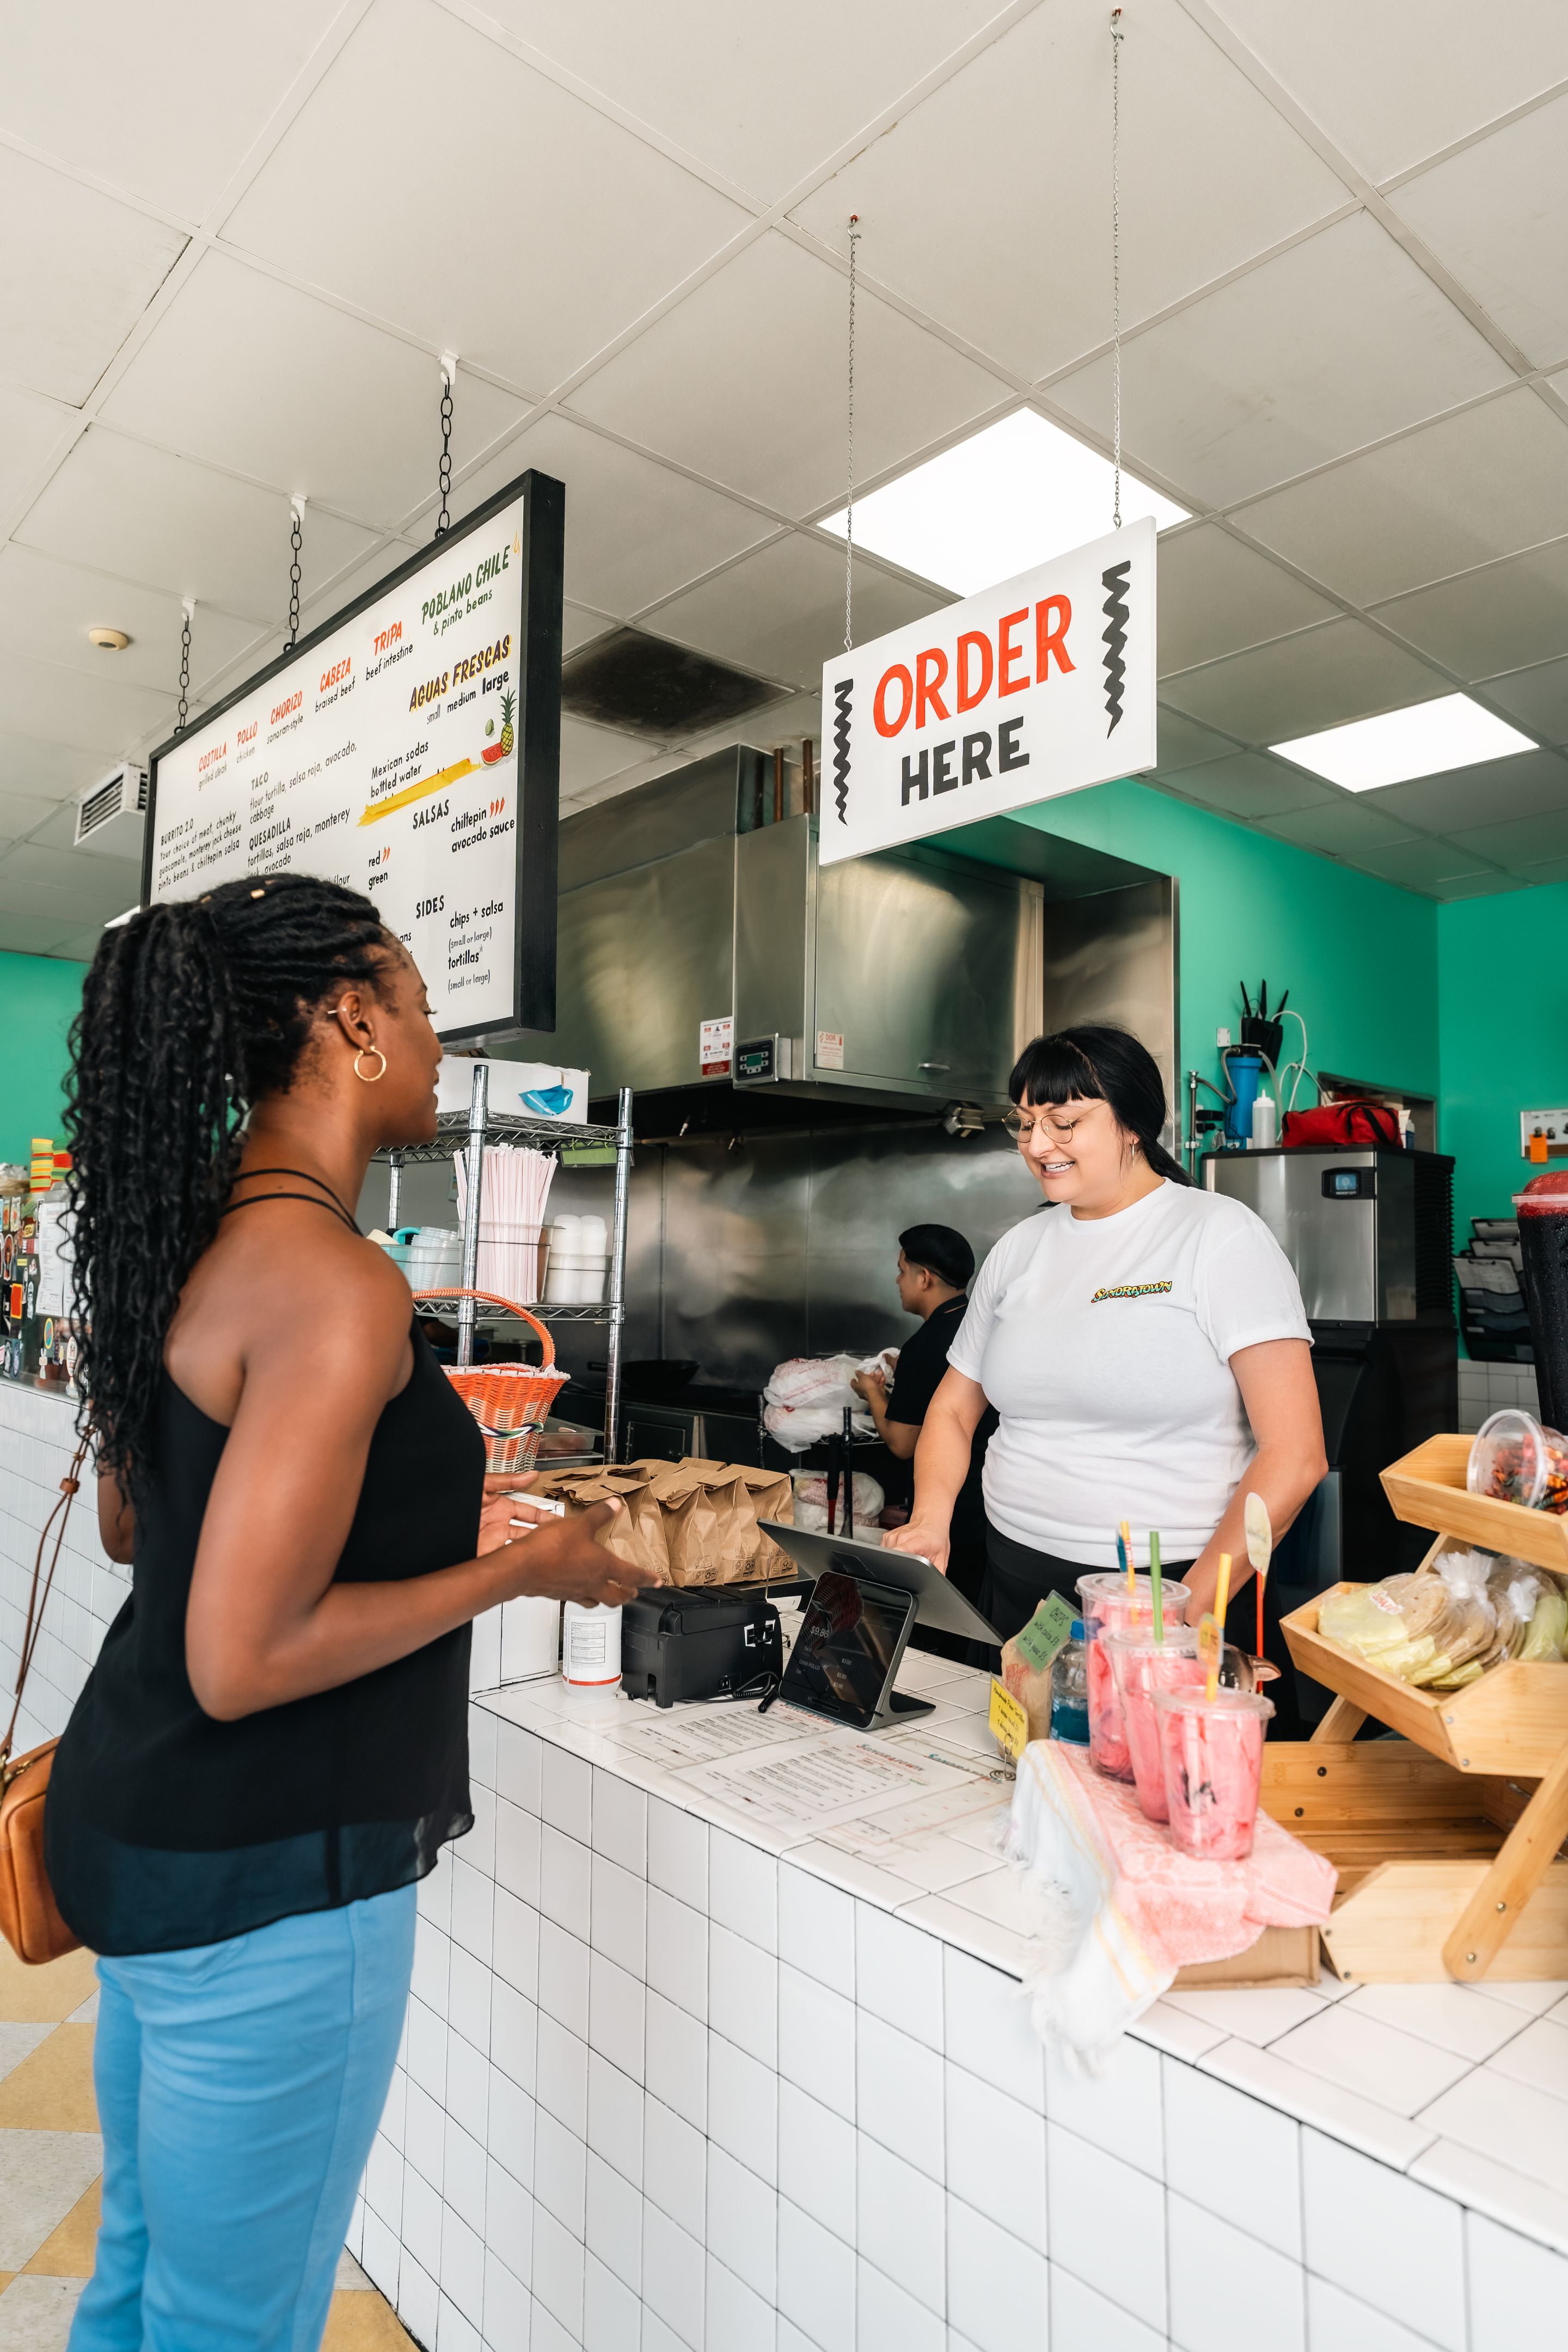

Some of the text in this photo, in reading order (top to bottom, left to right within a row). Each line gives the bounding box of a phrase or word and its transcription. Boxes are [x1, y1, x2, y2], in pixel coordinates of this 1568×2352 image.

[422, 544, 511, 626] POBLANO CHILE
[433, 589, 493, 636] & pinto beans
[374, 620, 402, 657] TRIPA
[320, 656, 351, 693] CABEZA
[366, 643, 413, 681] beef intestine
[409, 634, 512, 713] AGUAS FRESCAS
[873, 595, 1076, 738] ORDER
[270, 690, 303, 725] CHORIZO
[315, 675, 356, 713] braised beef
[427, 671, 510, 725] small medium large
[237, 721, 258, 748] POLLO
[267, 713, 304, 745] sonoran-style
[199, 742, 226, 773] COSTILLA
[236, 746, 255, 764] chicken
[371, 742, 428, 780] Mexican sodas
[902, 716, 1030, 806] HERE
[198, 762, 228, 791] grilled steak
[250, 740, 357, 811] flour tortilla, salsa roja, avocado,
[251, 771, 268, 791] TACO
[371, 764, 422, 798] bottled water
[250, 803, 274, 824] cabbage
[413, 799, 449, 830] SALSAS
[451, 807, 487, 833] chiltepin
[160, 811, 237, 861] Your choice of meat, chunky
[161, 818, 194, 846] BURRITO 2.0
[248, 808, 350, 868] tortillas, salsa roja, monterey
[249, 817, 291, 851] QUESADILLA
[451, 819, 515, 853] avocado sauce
[158, 839, 240, 894] pinto beans & chiltepin salsa
[159, 824, 242, 879] guacamole, monterey jack cheese
[265, 853, 291, 874] avocado
[369, 850, 380, 868] red
[368, 871, 388, 891] green
[416, 895, 445, 919] SIDES
[450, 900, 504, 929] chips + salsa
[449, 926, 492, 953] (small or large)
[448, 975, 464, 994] (small
[473, 969, 491, 984] large)
[1091, 1281, 1172, 1303] SONORATOWN
[810, 1626, 829, 1638] $9.86
[1049, 1607, 1069, 1627] CHIPS
[808, 1662, 820, 1670] POLLO
